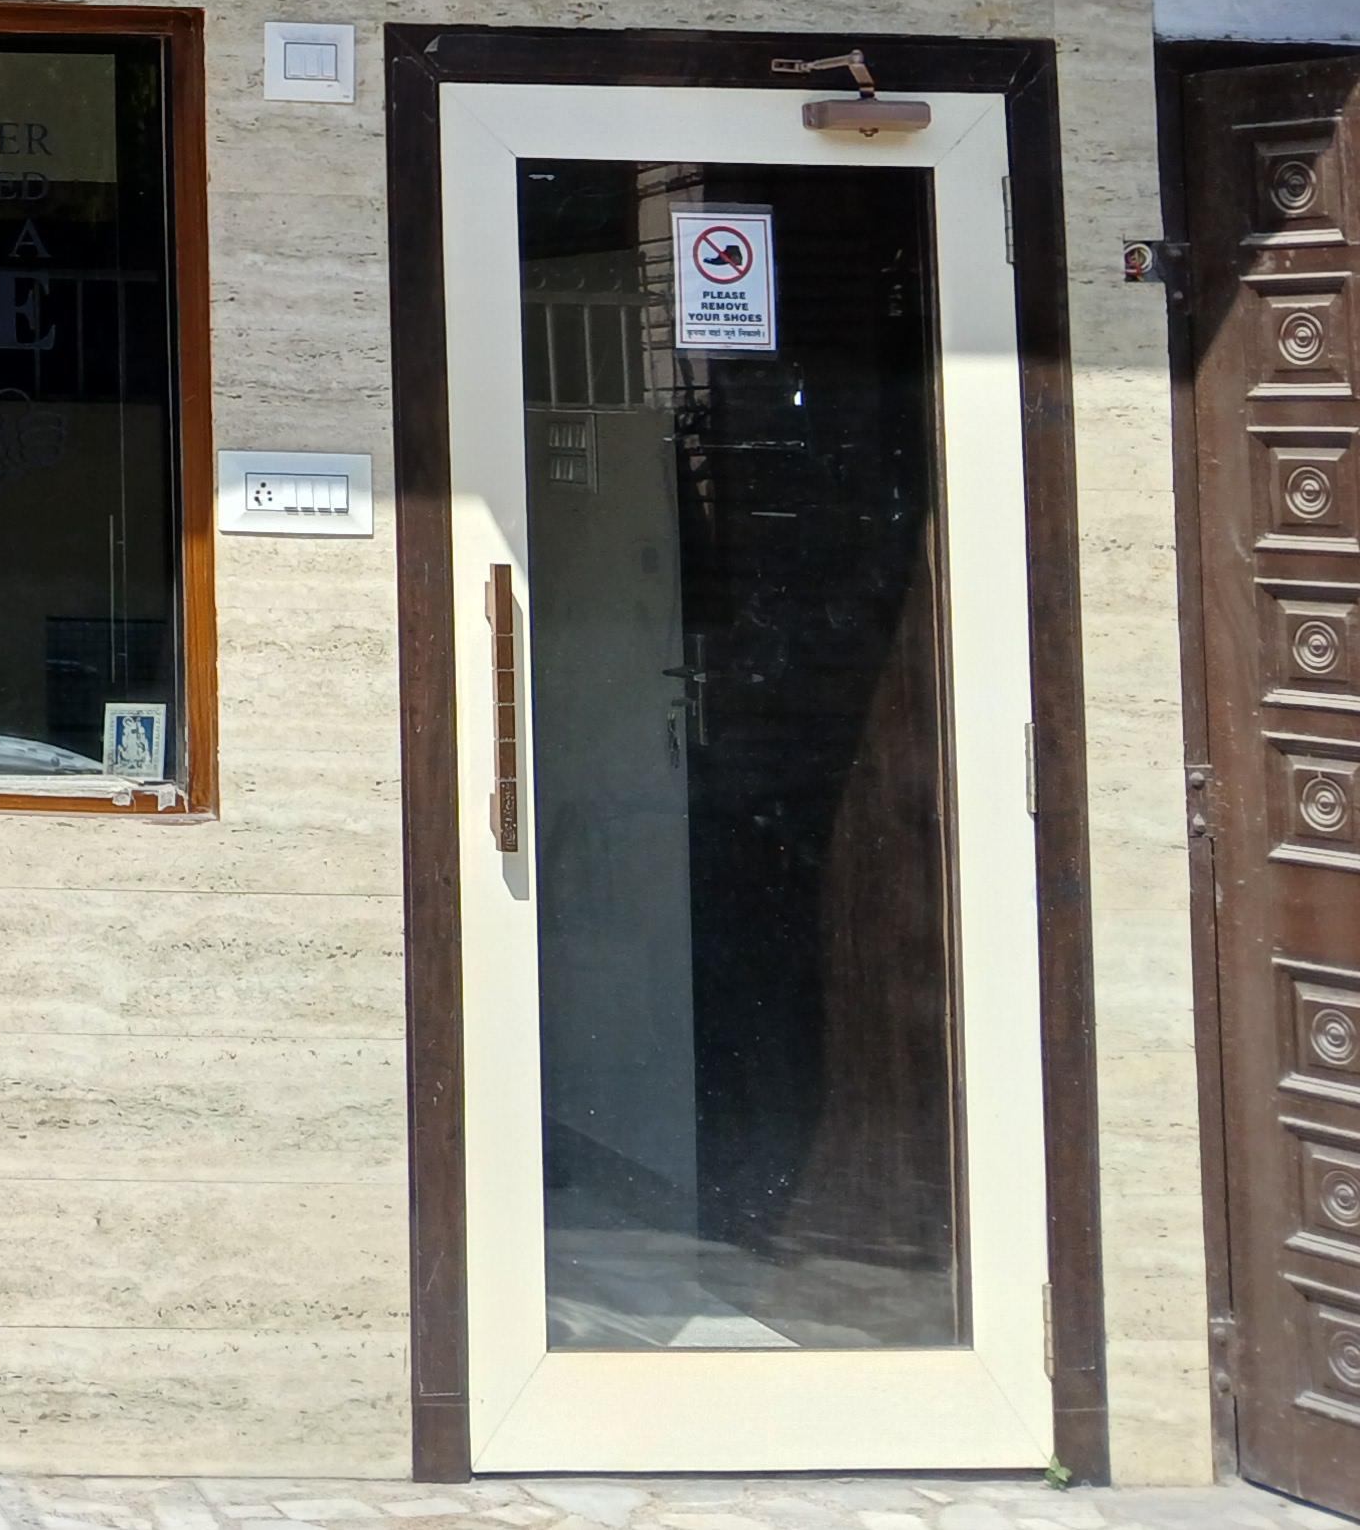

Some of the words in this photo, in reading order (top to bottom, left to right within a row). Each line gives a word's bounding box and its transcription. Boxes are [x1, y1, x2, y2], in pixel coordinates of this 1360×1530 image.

[8, 217, 53, 258] A
[702, 291, 746, 300] PLEASE
[700, 302, 749, 311] REMOVE
[688, 313, 720, 322] YOUR
[723, 313, 763, 323] SHOES
